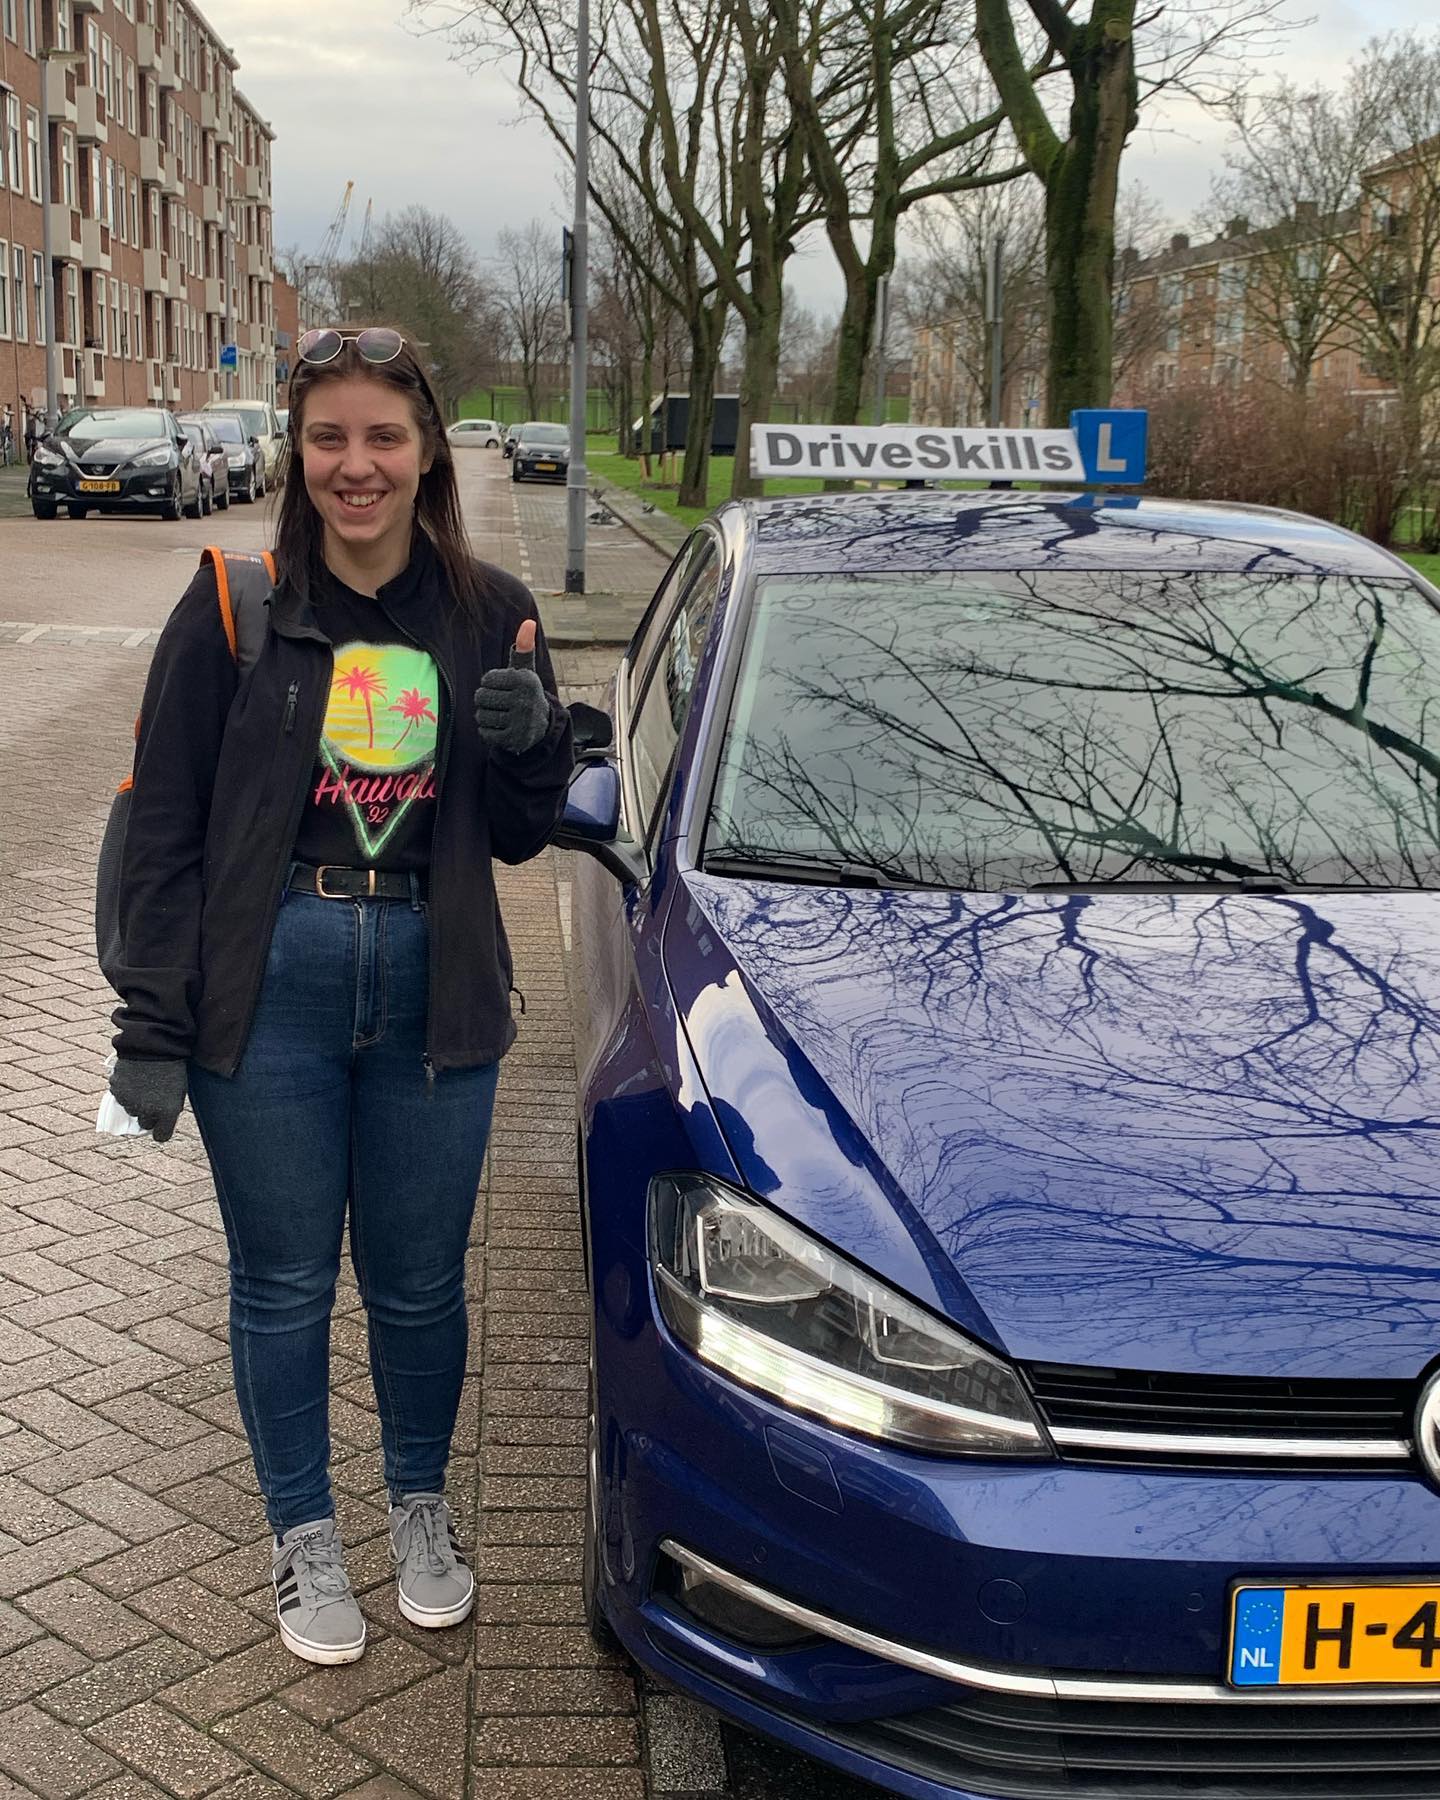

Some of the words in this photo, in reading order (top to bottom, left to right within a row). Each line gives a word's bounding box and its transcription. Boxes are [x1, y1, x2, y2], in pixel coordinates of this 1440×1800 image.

[765, 432, 1073, 472] DriveSkills
[1096, 423, 1127, 473] L
[1240, 1647, 1274, 1668] NL
[1303, 1600, 1440, 1670] H-4
